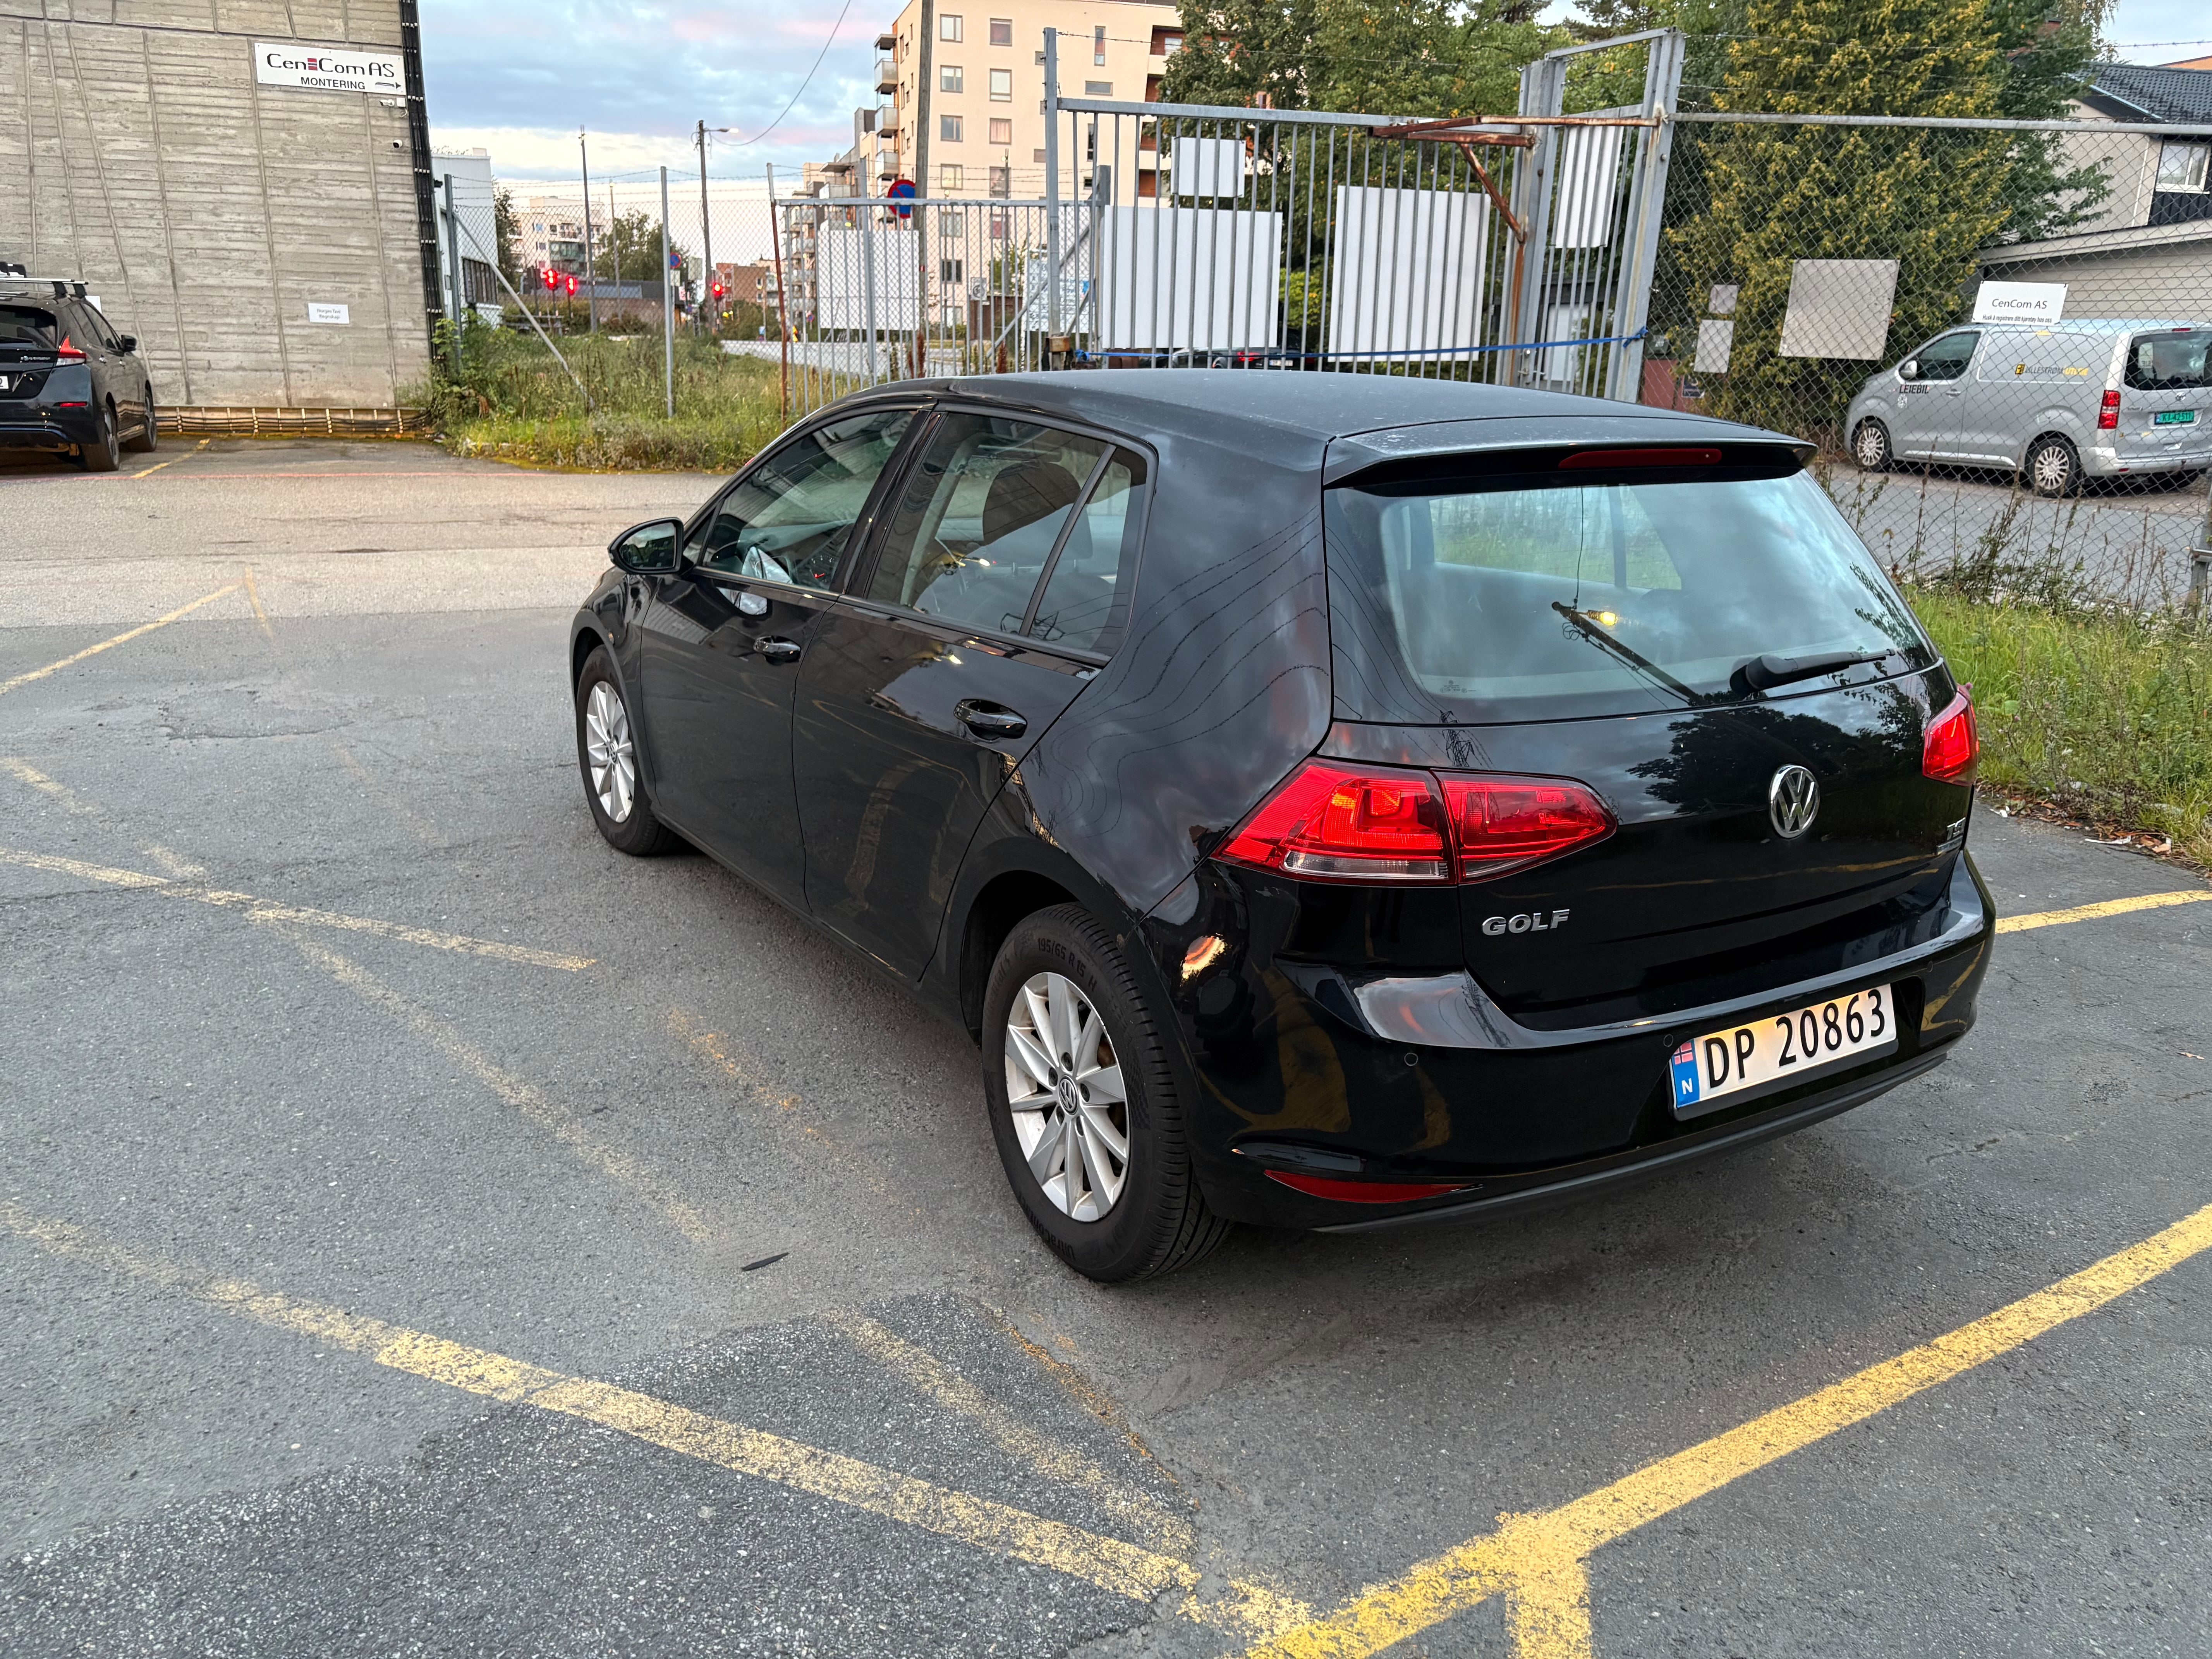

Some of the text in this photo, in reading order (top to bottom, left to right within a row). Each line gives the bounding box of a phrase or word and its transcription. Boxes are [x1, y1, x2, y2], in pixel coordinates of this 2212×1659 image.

[369, 62, 395, 77] AS
[301, 77, 365, 89] MONTERING
[1992, 299, 2047, 309] CenCom AS
[1482, 909, 1570, 936] GOLF
[1038, 938, 1097, 992] 195/65 R 15 H
[1704, 989, 1885, 1088] DP 20863
[1681, 1078, 1693, 1095] N
